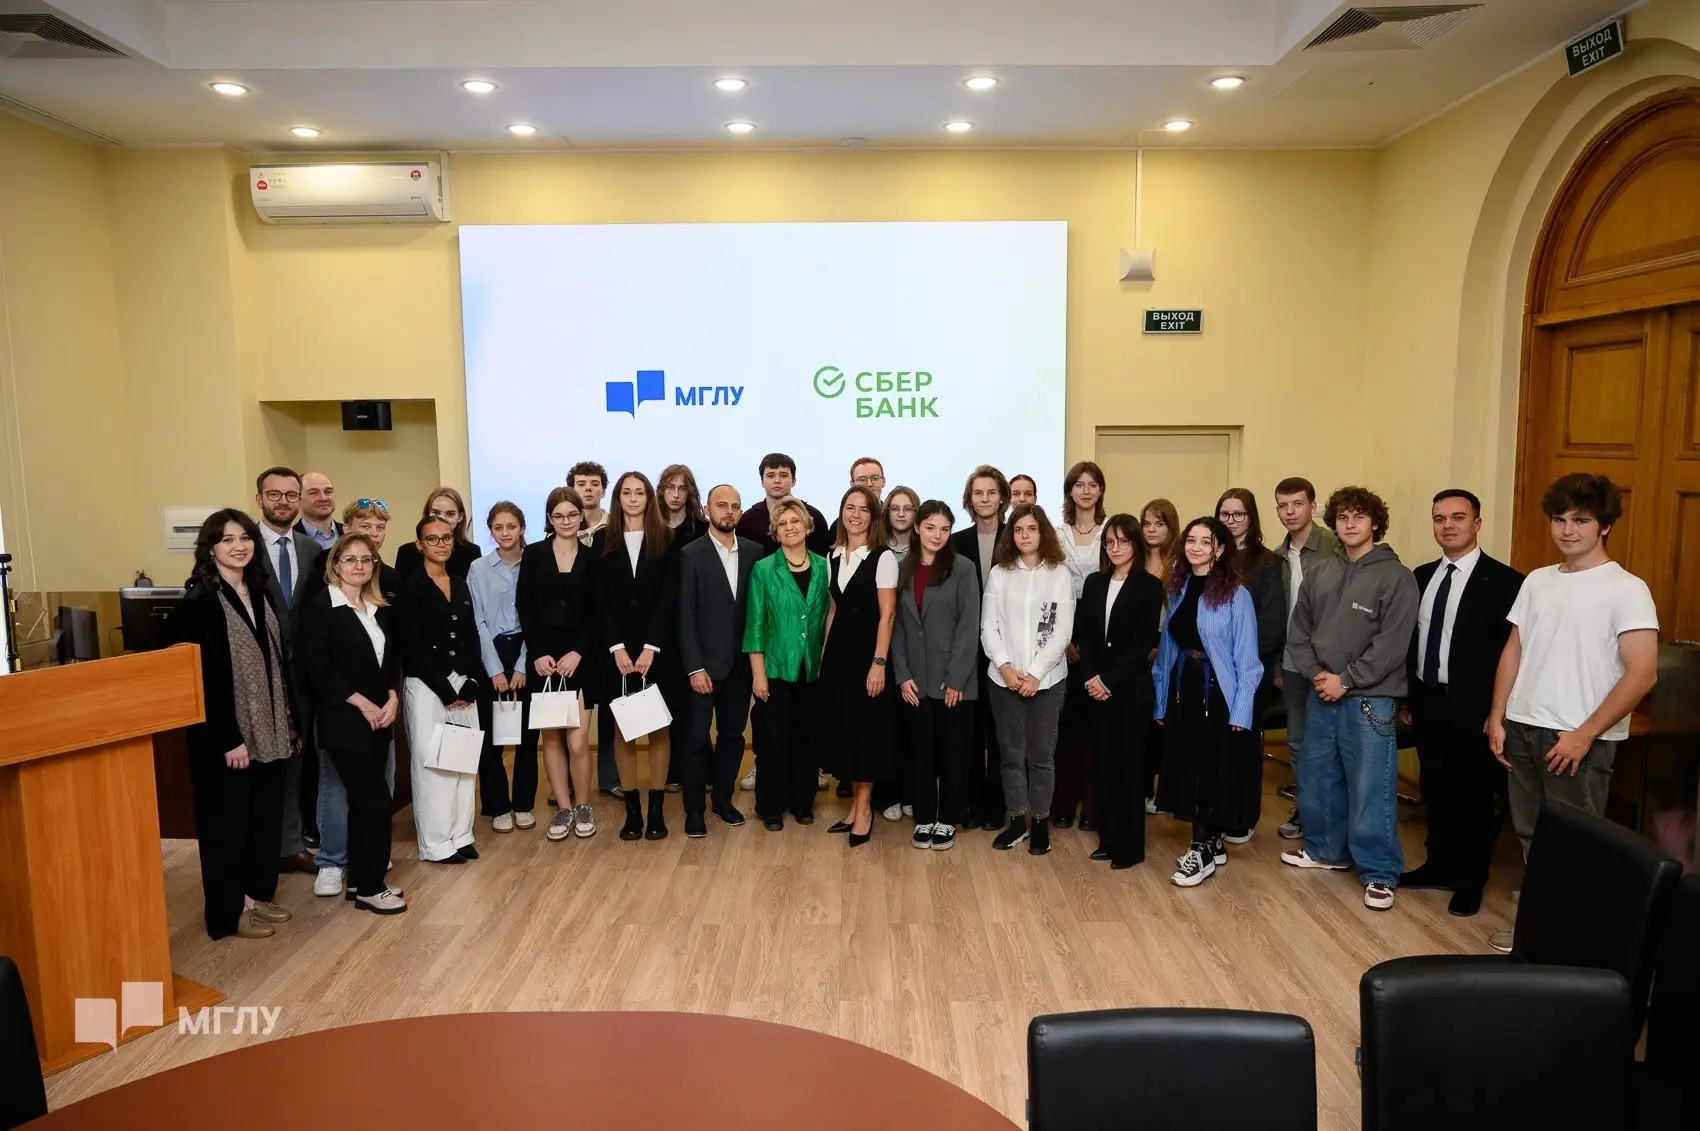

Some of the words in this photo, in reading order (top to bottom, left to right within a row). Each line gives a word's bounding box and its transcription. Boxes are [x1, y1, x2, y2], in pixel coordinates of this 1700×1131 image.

[1572, 28, 1613, 57] ВЫХОД
[1582, 46, 1605, 67] EXIT
[1152, 312, 1194, 321] ВЫХОД
[1160, 321, 1185, 330] EXIT
[855, 371, 933, 392] СБЕР
[675, 386, 744, 406] МГЛУ
[856, 397, 939, 418] БАНК
